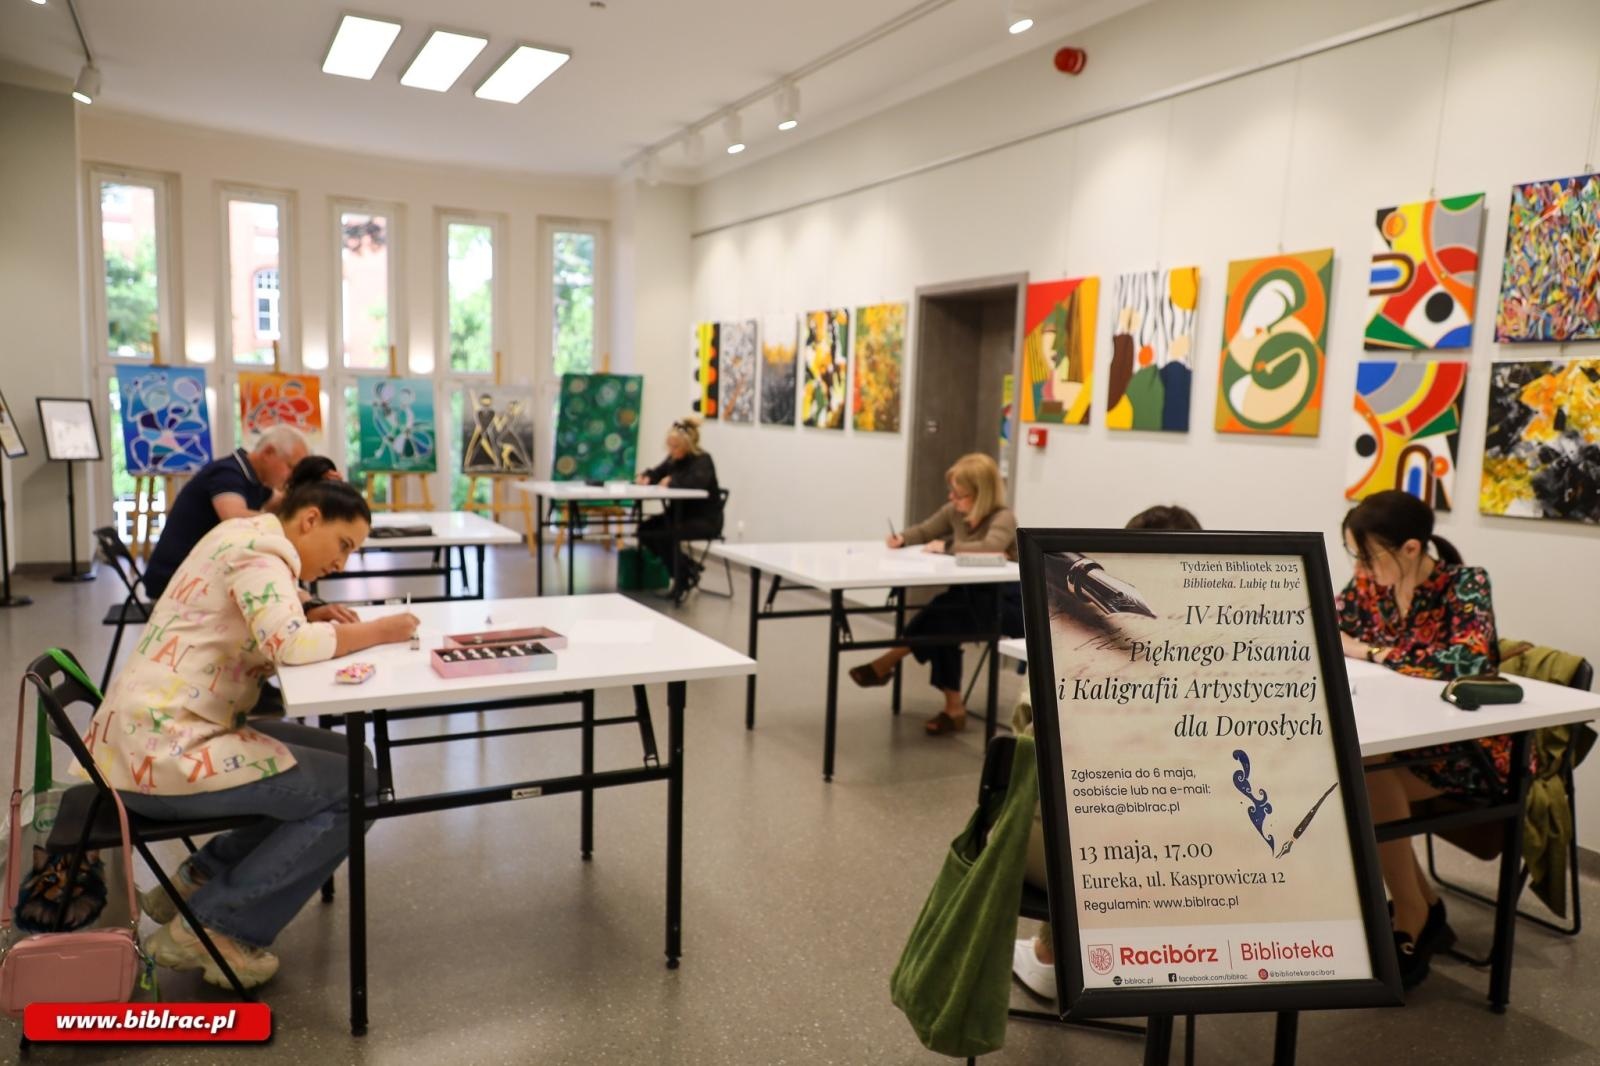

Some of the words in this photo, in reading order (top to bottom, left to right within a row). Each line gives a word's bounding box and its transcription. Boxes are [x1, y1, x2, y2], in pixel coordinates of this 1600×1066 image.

[1180, 560, 1223, 574] Tydzień
[1225, 560, 1272, 573] Bibliotek
[1275, 563, 1298, 573] 2025
[1183, 578, 1236, 590] Biblioteka.
[1239, 579, 1268, 591] Lubię
[1270, 580, 1281, 590] tu
[1283, 577, 1301, 592] być
[1185, 605, 1210, 625] IV
[1216, 604, 1305, 626] Konkurs
[1129, 640, 1225, 667] Pięknego
[1231, 640, 1311, 662] Pisania
[1058, 679, 1066, 701] i
[1073, 676, 1178, 704] Kaligrafii
[1183, 676, 1318, 704] Artystycznej
[1174, 714, 1208, 737] dla
[1215, 712, 1324, 741] Dorosłych
[1071, 769, 1132, 783] Zgłoszenia
[1135, 768, 1151, 779] do
[1153, 767, 1161, 778] 6
[1163, 767, 1196, 780] maja,
[1072, 785, 1128, 797] osobiście
[1130, 785, 1149, 796] lub
[1151, 786, 1167, 795] na
[1169, 784, 1211, 795] e-mail:
[1074, 801, 1180, 816] eureka@biblrac.pl
[1079, 846, 1098, 864] 13
[1104, 840, 1158, 864] maja,
[1164, 843, 1213, 861] 17.00
[1082, 872, 1143, 890] Eureka,
[1146, 871, 1166, 887] ul.
[1170, 869, 1267, 889] Kasprowicza
[1271, 871, 1286, 884] 12
[1084, 899, 1150, 914] Regulamin:
[1153, 895, 1240, 909] www.biblrac.pl
[1120, 944, 1218, 966] Racibórz
[1241, 940, 1334, 961] Biblioteka
